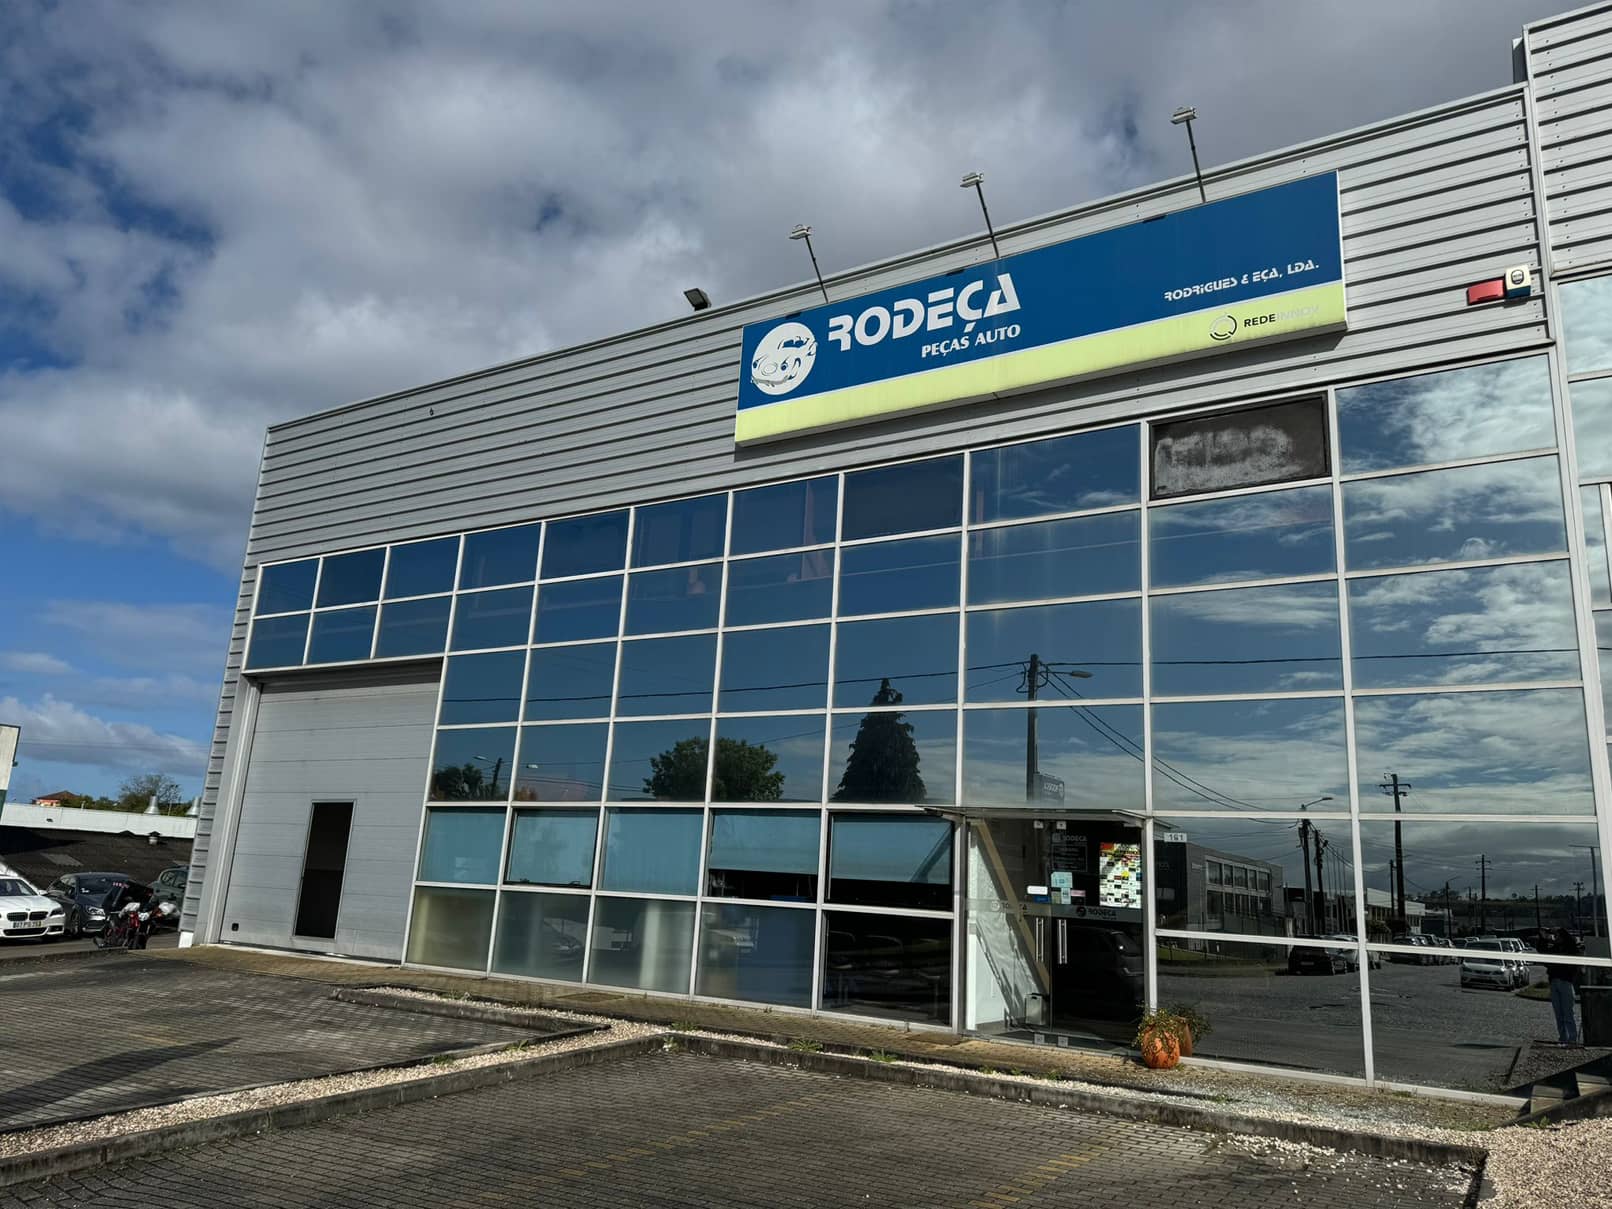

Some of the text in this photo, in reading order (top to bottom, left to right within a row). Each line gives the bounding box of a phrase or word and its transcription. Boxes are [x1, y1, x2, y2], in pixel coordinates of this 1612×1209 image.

[1252, 267, 1283, 283] EÇA,
[1287, 259, 1320, 275] LDA.
[828, 273, 1021, 352] RODEÇA
[921, 324, 1021, 358] PEÇAS AUTO
